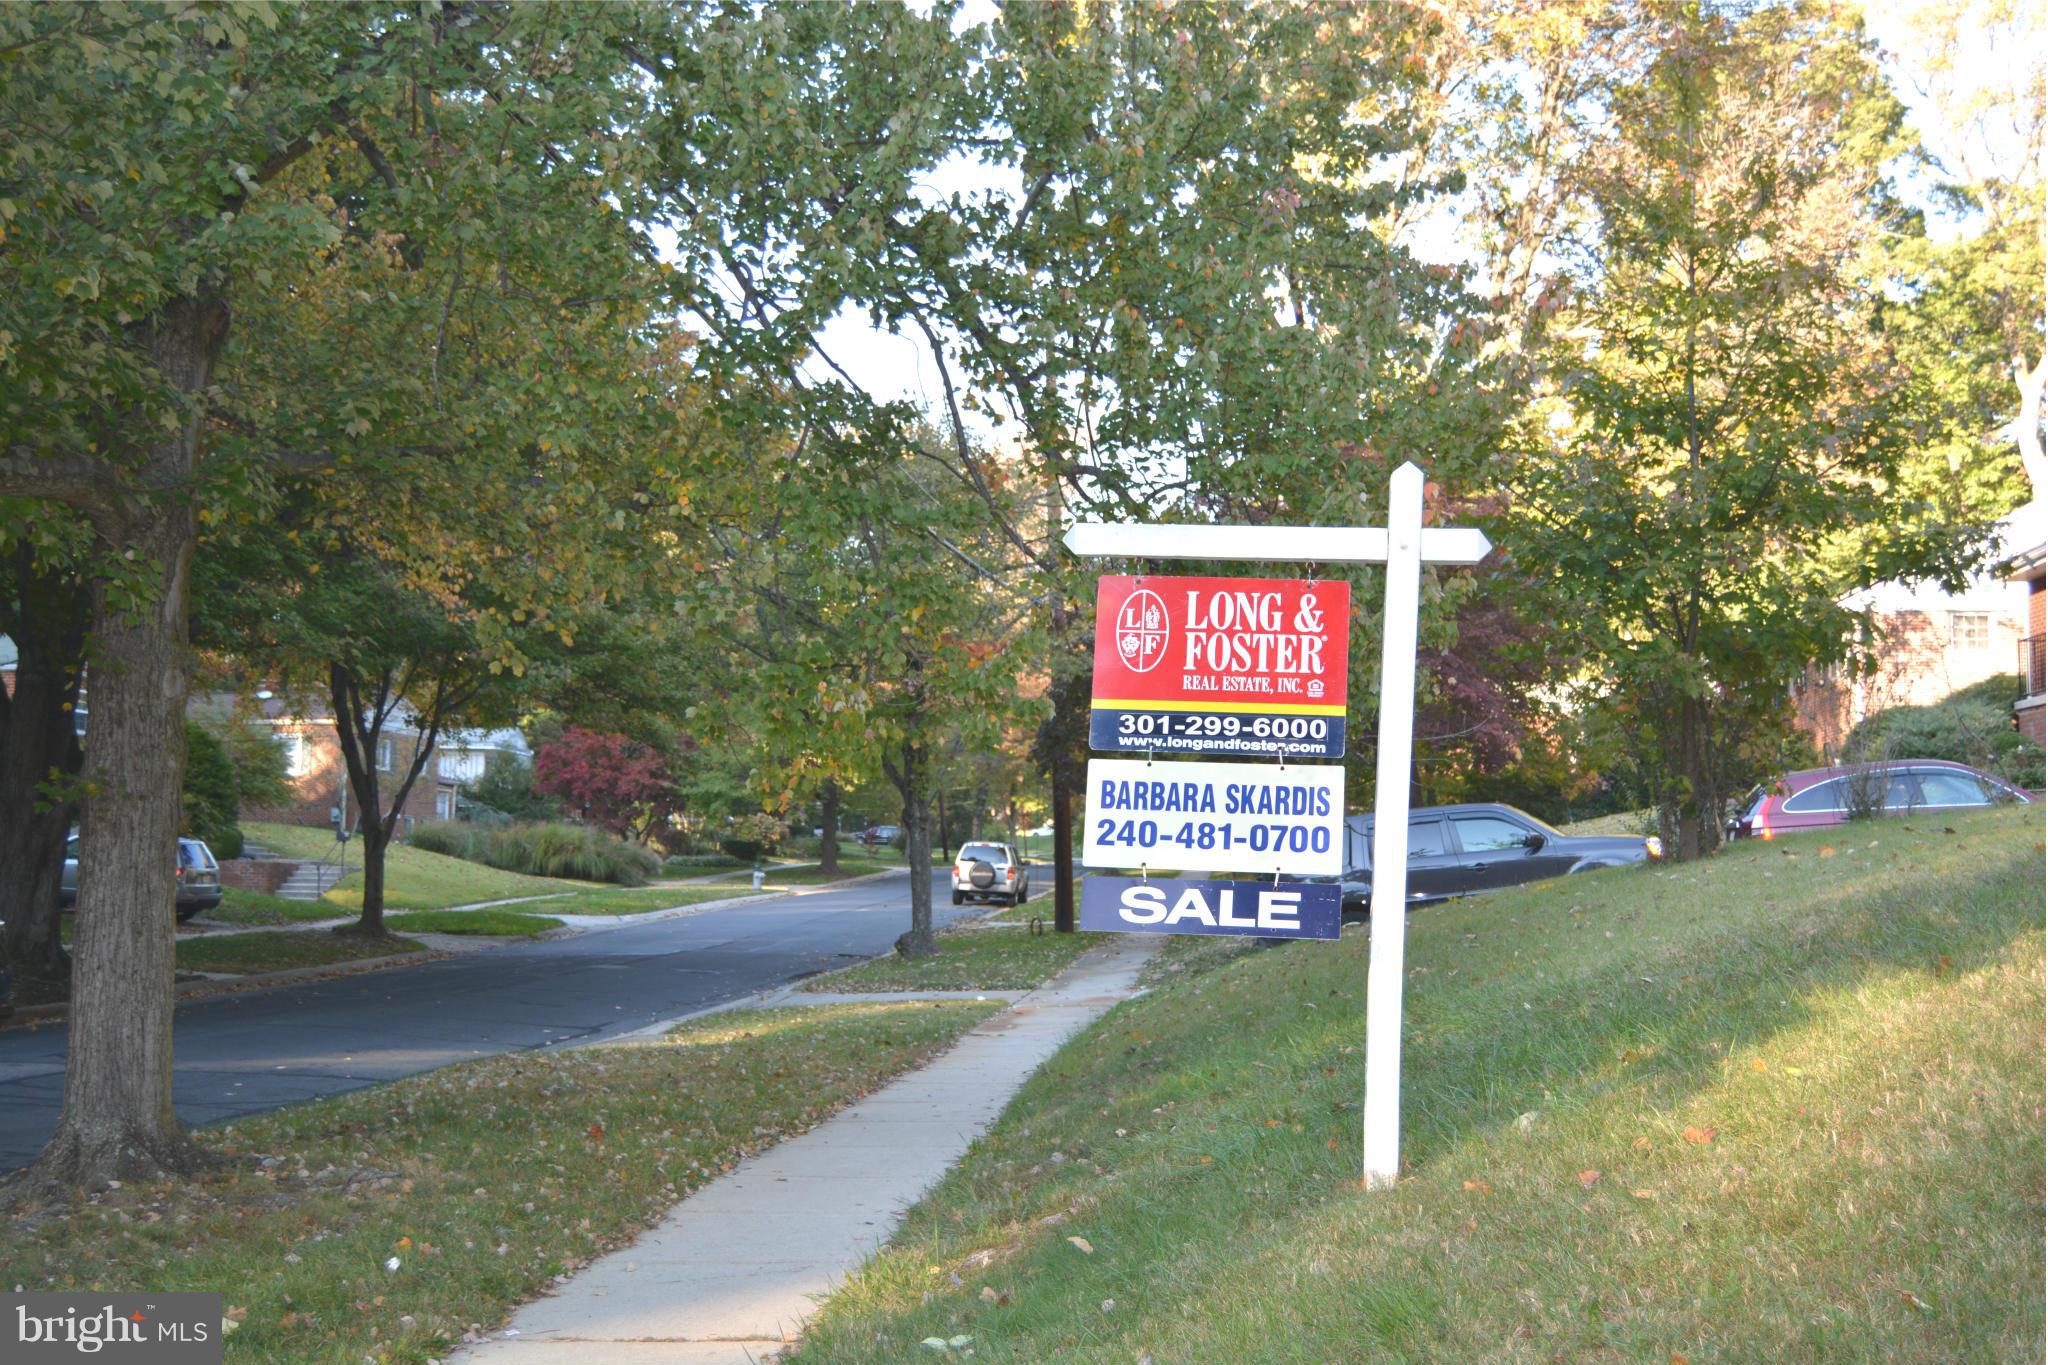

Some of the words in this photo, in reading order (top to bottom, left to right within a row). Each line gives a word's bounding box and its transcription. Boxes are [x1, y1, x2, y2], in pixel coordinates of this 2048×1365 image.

[1125, 608, 1141, 628] L
[1185, 590, 1282, 632] LONG
[1293, 593, 1324, 633] &
[1144, 635, 1160, 655] F
[1183, 632, 1325, 675] FOSTER
[1182, 675, 1218, 691] REAL
[1222, 676, 1274, 695] ESTATE,
[1277, 678, 1303, 694] INC.
[1118, 714, 1327, 740] 301-299-6000
[1118, 736, 1326, 754] www.longandfoster.com
[1100, 780, 1216, 813] BARBARA
[1225, 783, 1331, 817] SKARDIS
[1096, 818, 1331, 854] 240-481-0700
[1118, 886, 1301, 930] SALE
